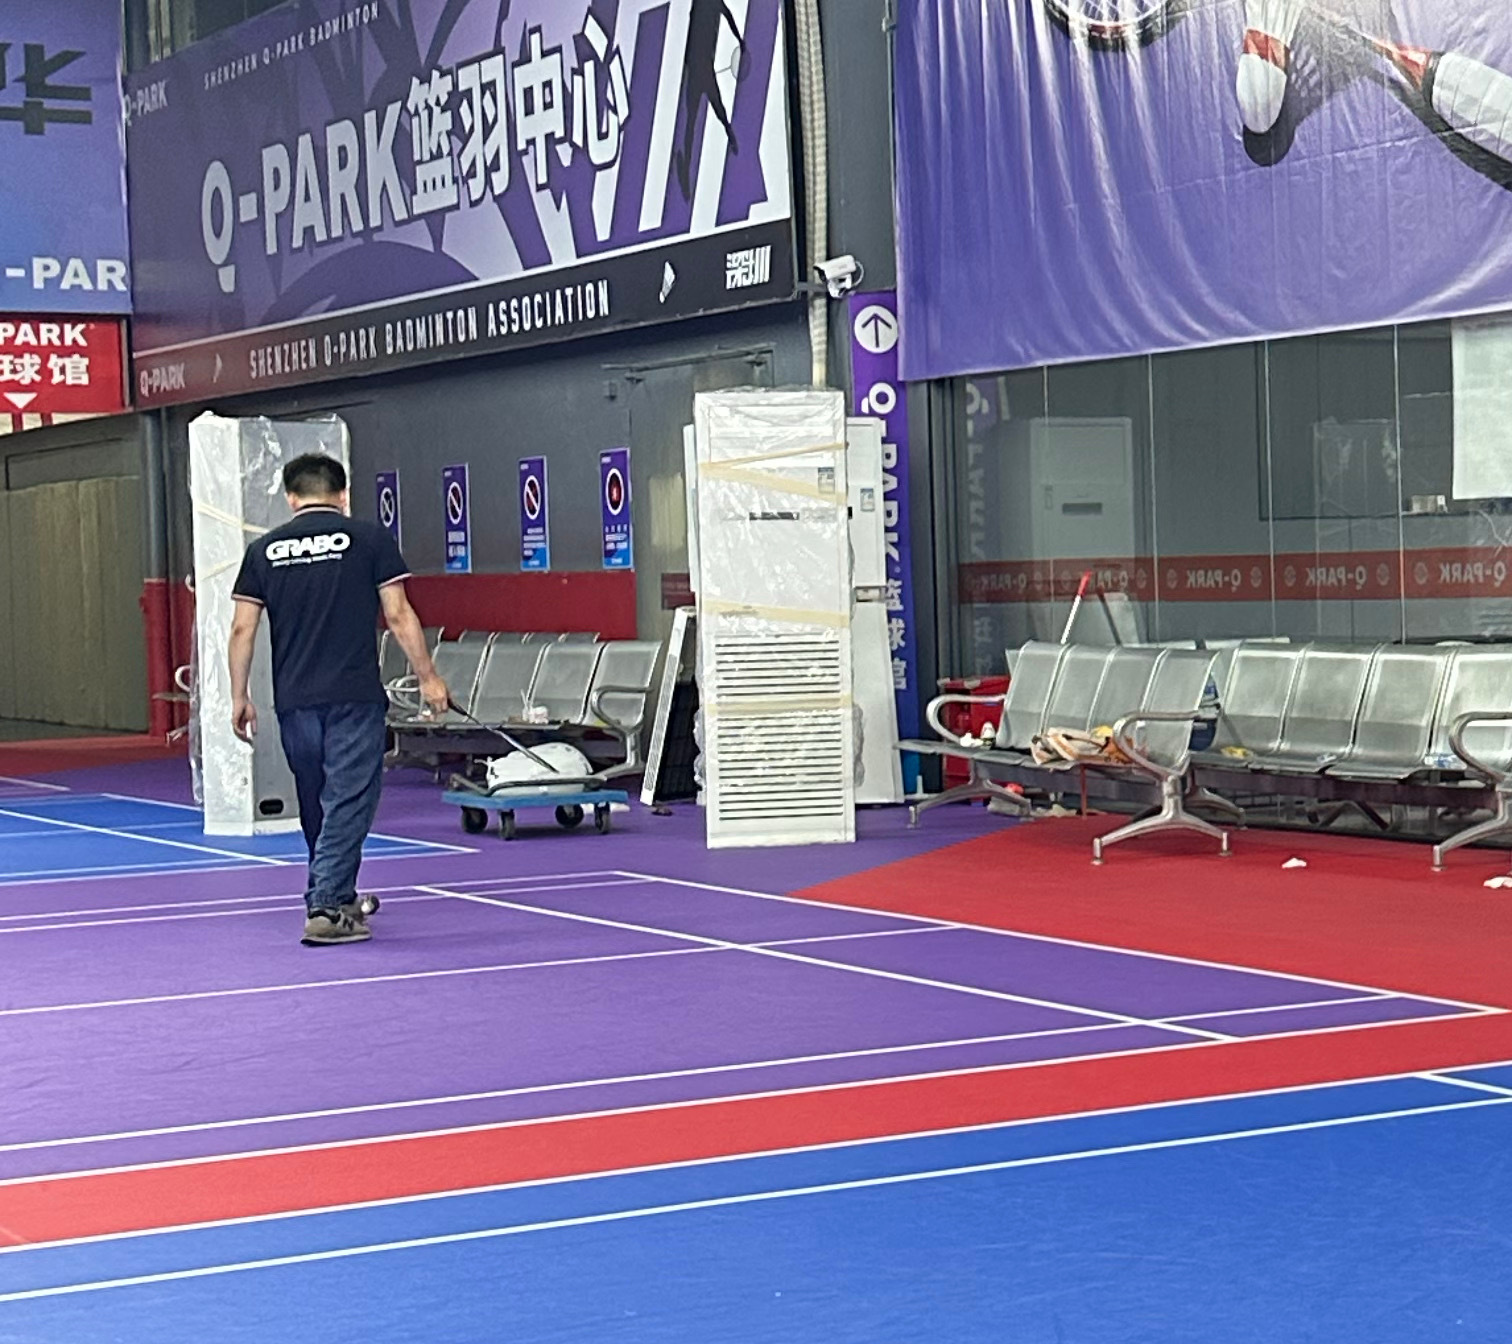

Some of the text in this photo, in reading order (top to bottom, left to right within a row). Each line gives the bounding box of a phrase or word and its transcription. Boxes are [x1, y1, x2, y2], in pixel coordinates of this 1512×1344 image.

[309, 0, 379, 47] BADMINTON
[201, 14, 630, 293] Q-PARK篮羽中心
[249, 338, 317, 380] SHENZHEN
[385, 306, 478, 354] BADMINTON
[487, 279, 609, 337] ASSOCIATION
[265, 532, 351, 561] GRABO
